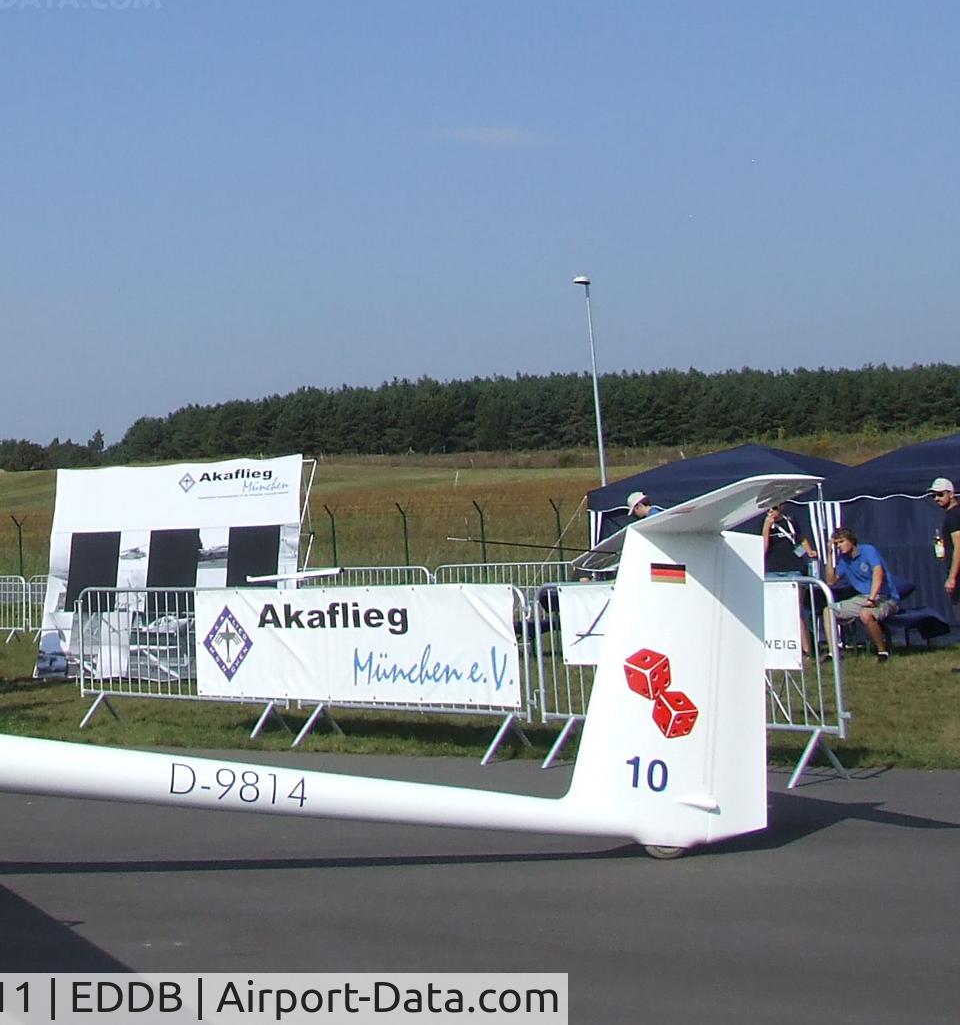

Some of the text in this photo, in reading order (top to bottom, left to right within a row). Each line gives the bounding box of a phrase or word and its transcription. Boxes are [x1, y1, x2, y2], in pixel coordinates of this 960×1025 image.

[199, 469, 273, 481] Akaflieg
[242, 477, 289, 493] München
[257, 602, 409, 635] Akaflieg
[353, 643, 464, 686] München
[170, 763, 307, 807] D-9814
[626, 756, 668, 792] 10
